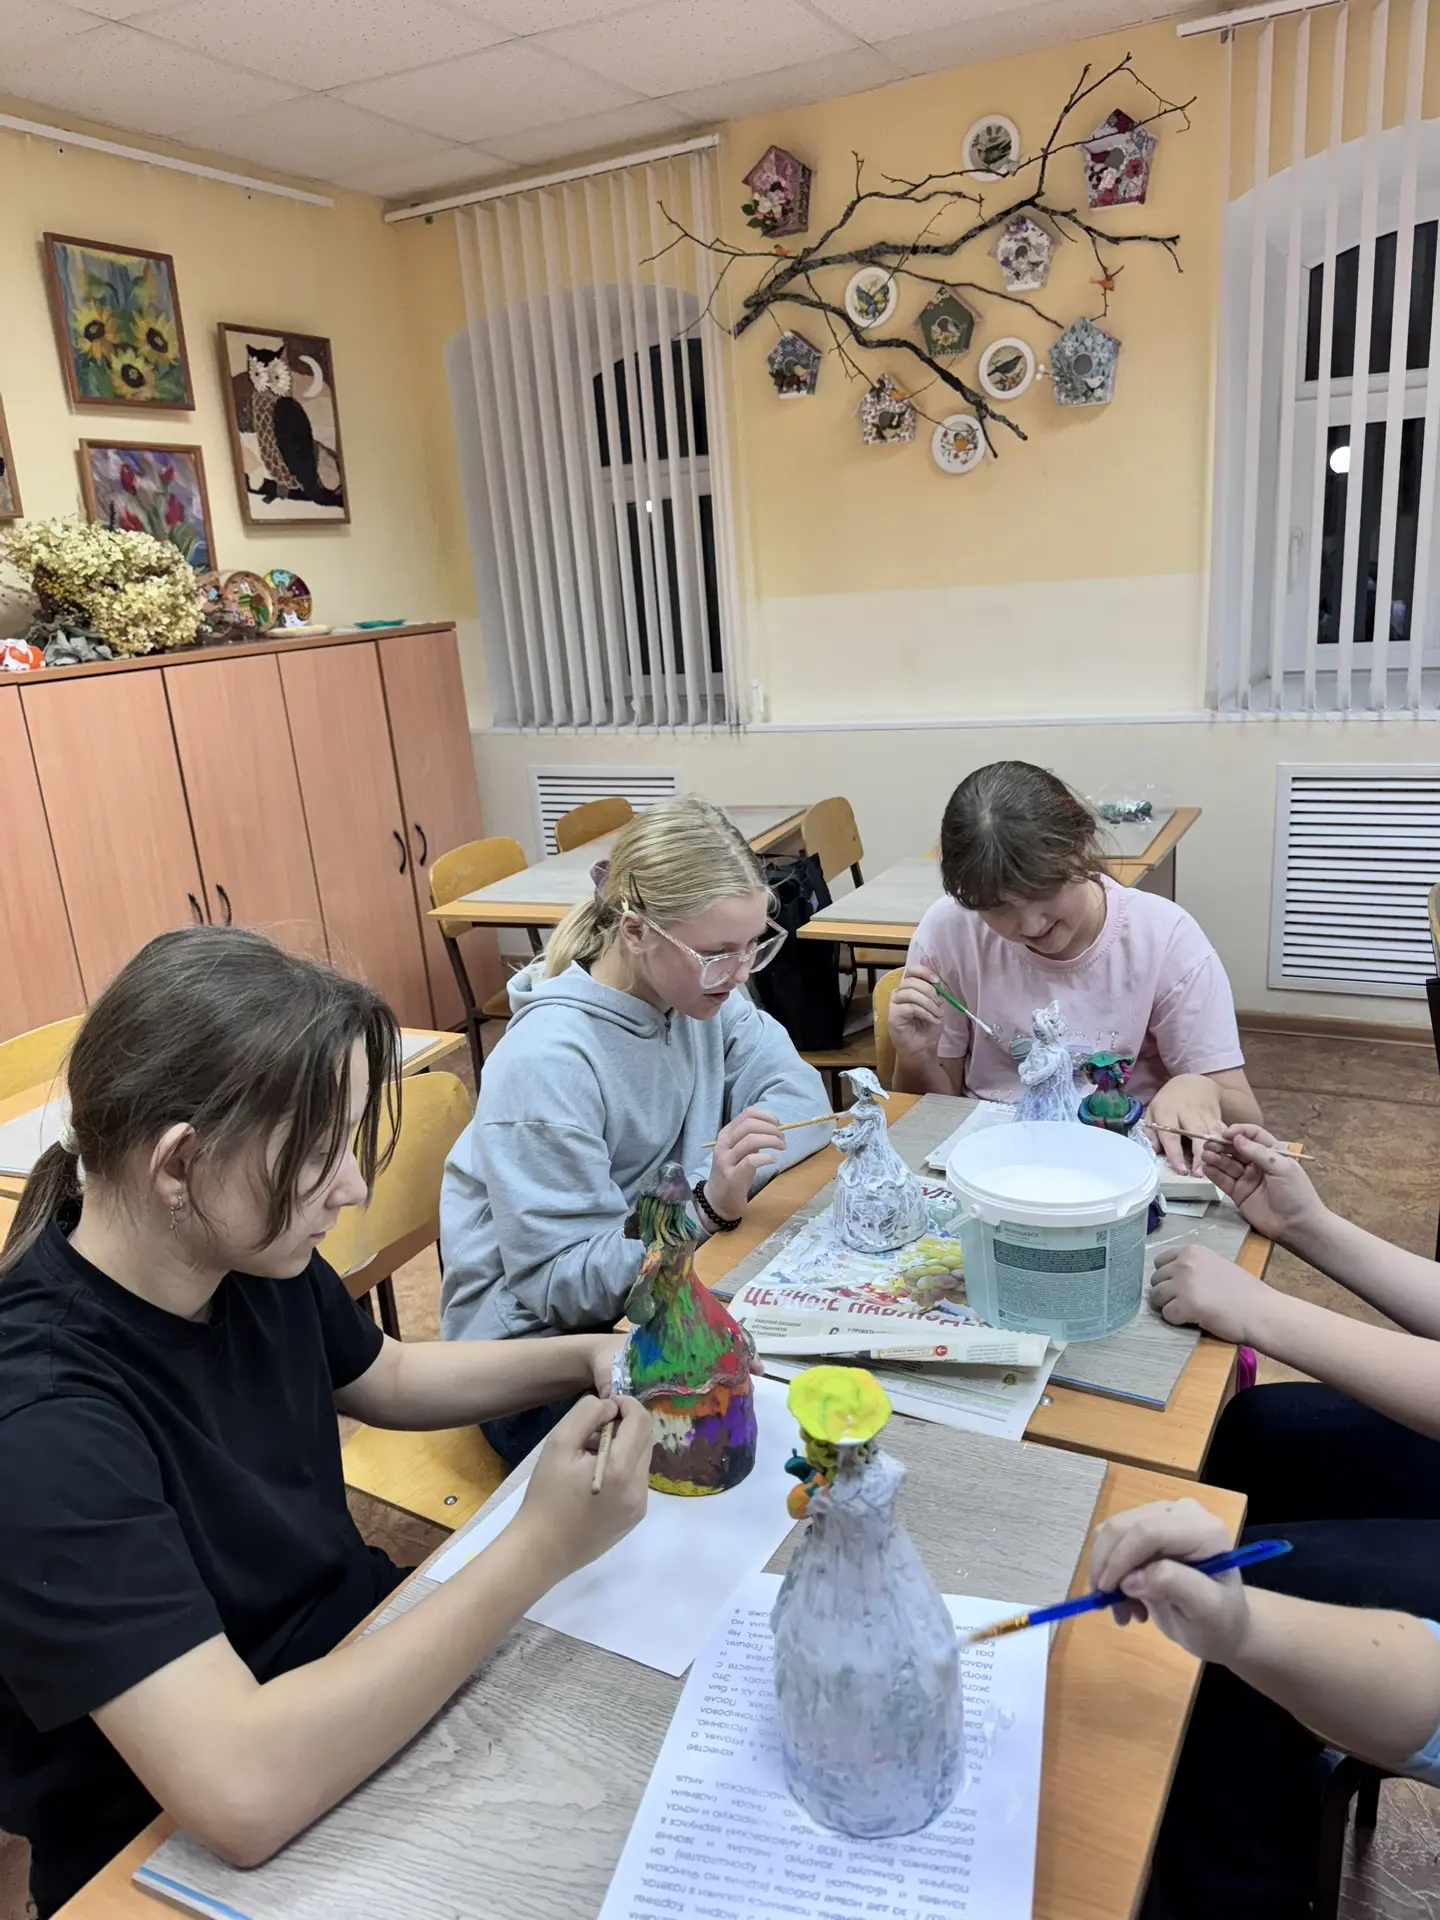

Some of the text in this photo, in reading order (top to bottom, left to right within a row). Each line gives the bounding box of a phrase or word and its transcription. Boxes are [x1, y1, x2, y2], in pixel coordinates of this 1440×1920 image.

[728, 1663, 765, 1672] вместе
[711, 1673, 732, 1682] Это
[707, 1684, 728, 1693] был
[704, 1696, 737, 1706] После
[699, 1706, 778, 1724] экспонировал
[686, 1744, 735, 1756] качестве
[676, 1775, 704, 1785] лишь
[666, 1803, 700, 1813] начал
[670, 1789, 974, 1847] работат писал главным
[671, 1818, 723, 1833] вернулся
[655, 1831, 695, 1844] звание
[725, 1828, 802, 1850] Айвазовский
[651, 1847, 666, 1855] он
[726, 1843, 772, 1858] медаль
[806, 1842, 814, 1850] г.
[817, 1845, 843, 1858] 1838
[785, 1853, 833, 1870] золотую
[849, 1851, 895, 1867] Весной
[645, 1862, 701, 1879] Финском
[704, 1872, 720, 1881] на
[784, 1869, 816, 1883] рейд
[847, 1865, 905, 1884] большую
[919, 1876, 969, 1893] получил
[699, 1888, 745, 1903] отклики
[774, 1885, 820, 1901] работы
[899, 1891, 907, 1899] и
[633, 1893, 686, 1912] Картины
[748, 1897, 812, 1917] появились
[825, 1895, 862, 1908] новые
[867, 1902, 889, 1912] две
[894, 1907, 906, 1915] за
